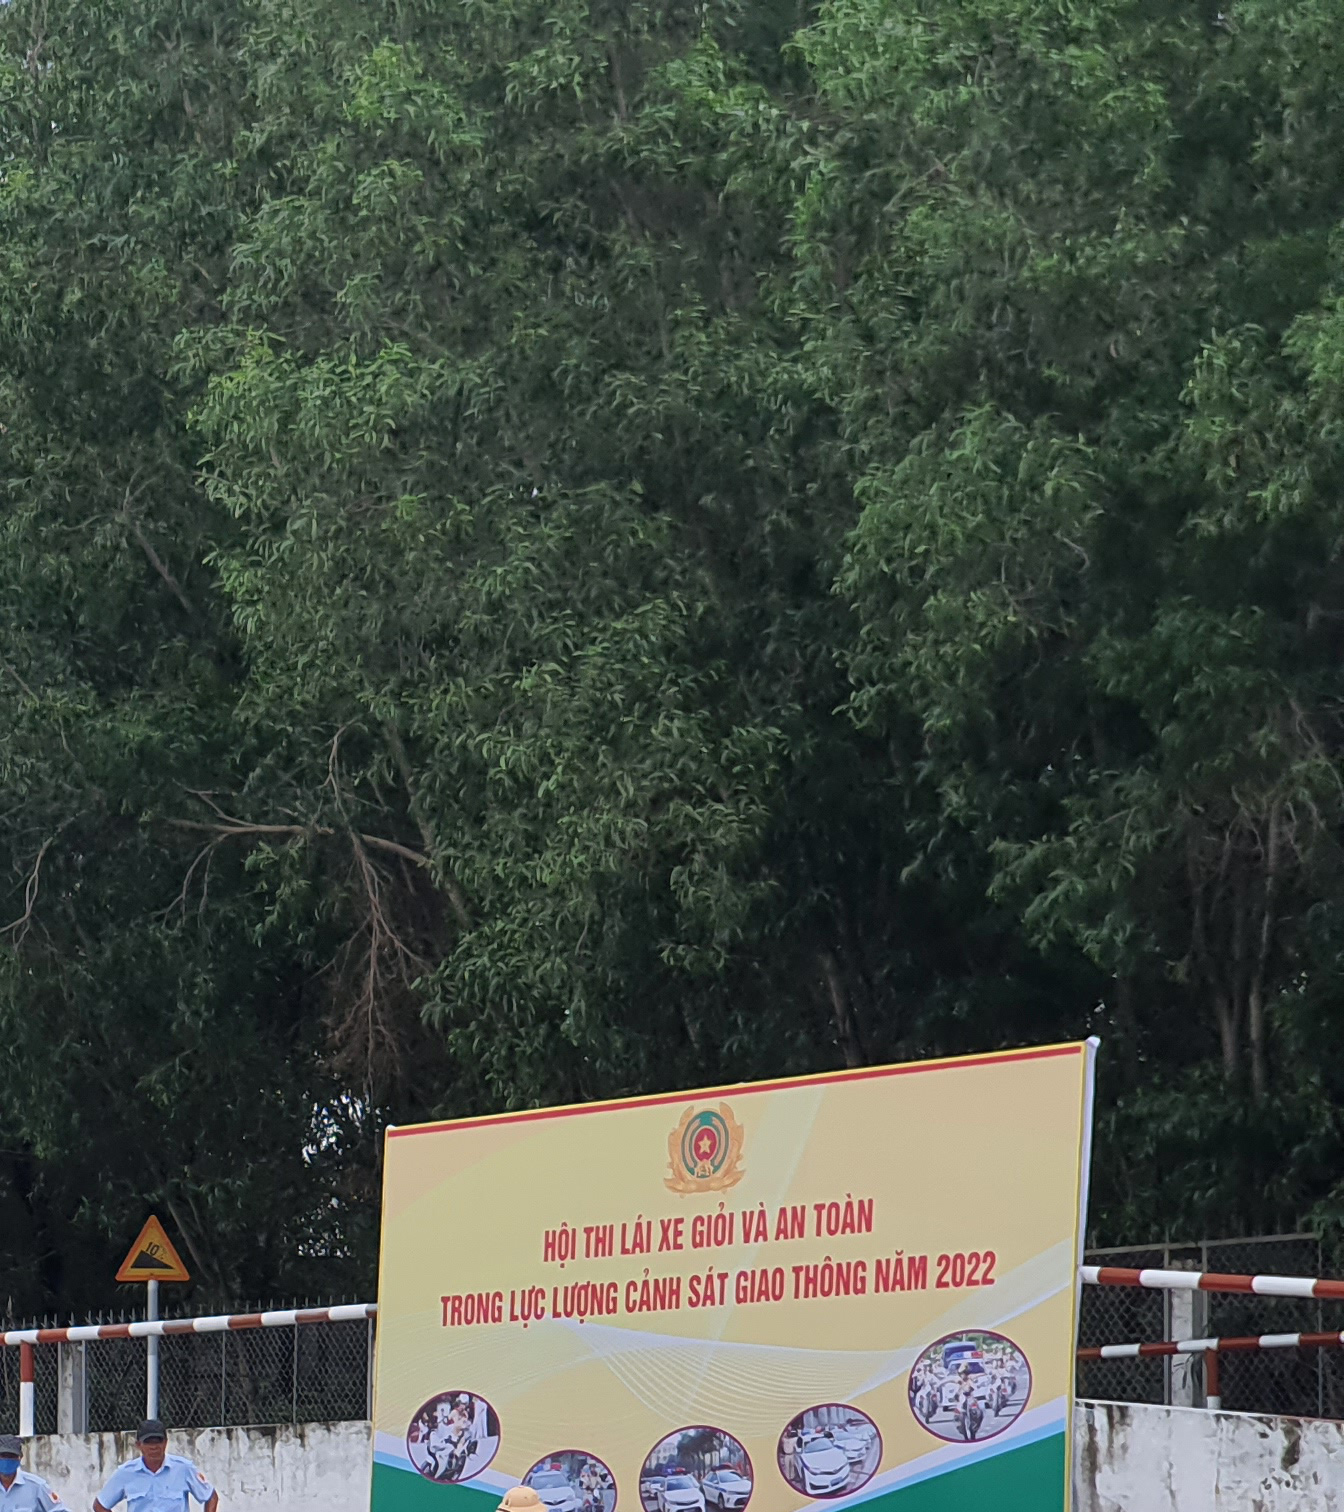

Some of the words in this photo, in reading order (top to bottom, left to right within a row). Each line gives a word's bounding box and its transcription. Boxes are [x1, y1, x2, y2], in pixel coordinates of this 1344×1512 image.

[543, 1222, 576, 1268] HỘI
[583, 1224, 614, 1258] THI
[620, 1214, 652, 1255] LÁI
[658, 1217, 684, 1252] XE
[691, 1202, 734, 1249] GIỎI
[742, 1202, 768, 1244] VÀ
[774, 1205, 806, 1241] AN
[813, 1193, 873, 1237] TOÀN
[441, 1291, 503, 1327] TRONG
[509, 1285, 546, 1328] LỰC
[552, 1281, 618, 1324] LƯỢNG
[625, 1268, 681, 1313] CẢNH
[687, 1266, 729, 1308] SÁT
[735, 1267, 784, 1304] GIAO
[792, 1256, 867, 1300] THÔNG
[874, 1249, 927, 1293] NĂM
[935, 1250, 996, 1289] 2022
